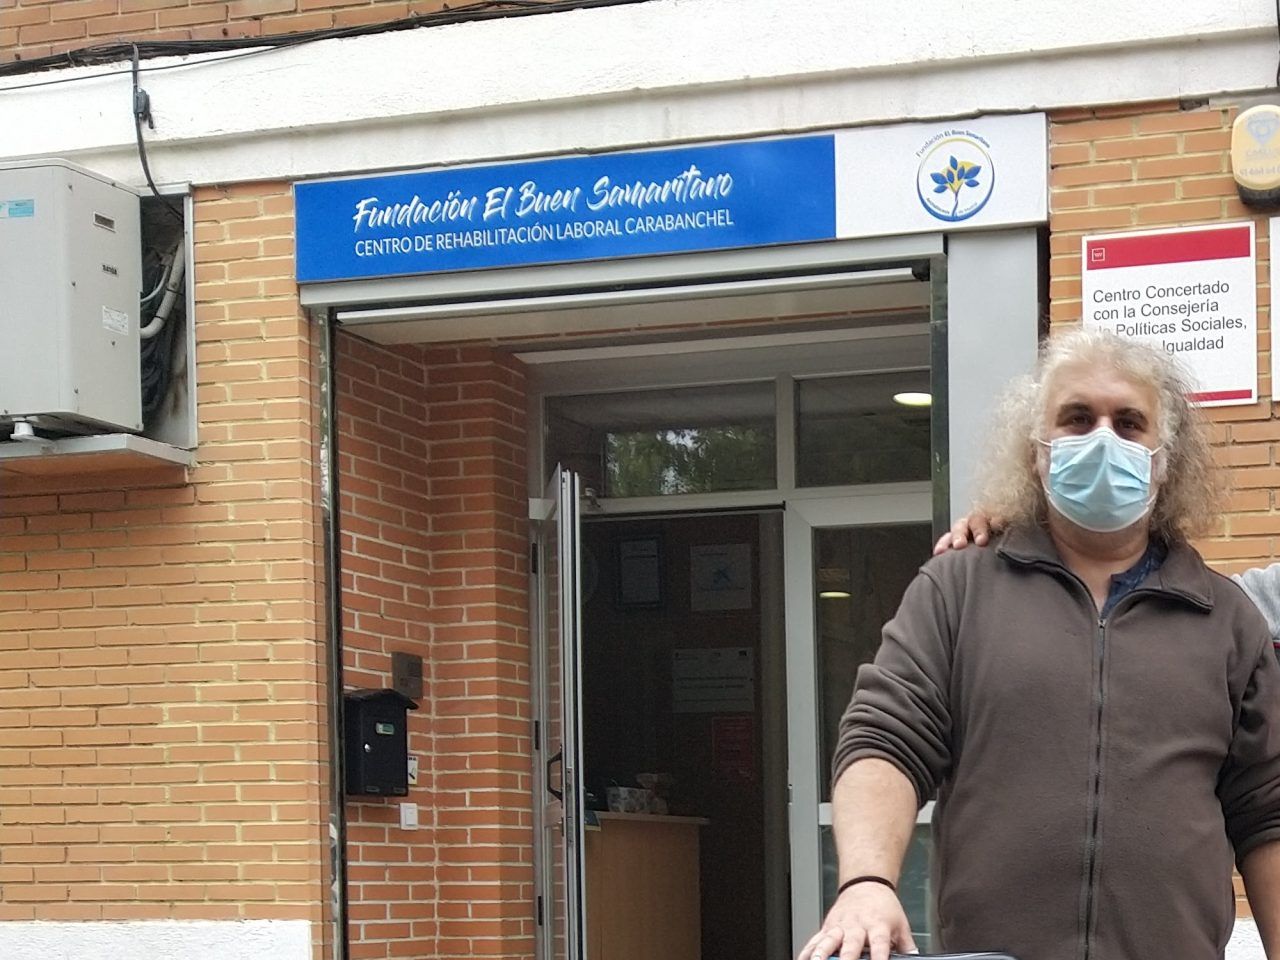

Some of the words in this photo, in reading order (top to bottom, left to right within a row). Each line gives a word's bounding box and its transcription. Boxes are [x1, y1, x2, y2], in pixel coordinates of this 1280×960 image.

[352, 190, 477, 233] Fundación
[483, 186, 514, 221] El
[515, 181, 581, 217] Buen
[586, 164, 733, 211] Samaritano
[354, 236, 412, 257] CENTRO
[414, 234, 433, 252] DE
[436, 222, 553, 250] REHABILITACIÓN
[556, 219, 622, 240] LABORAL
[624, 208, 735, 234] CARABANCHEL
[1093, 288, 1141, 303] Centro
[1145, 280, 1230, 299] Concertado
[1093, 309, 1119, 321] con
[1123, 305, 1136, 318] la
[1140, 299, 1219, 317] Consejería
[1116, 322, 1177, 337] Políticas
[1181, 316, 1247, 333] Sociales,
[1162, 335, 1224, 356] Igualdad
